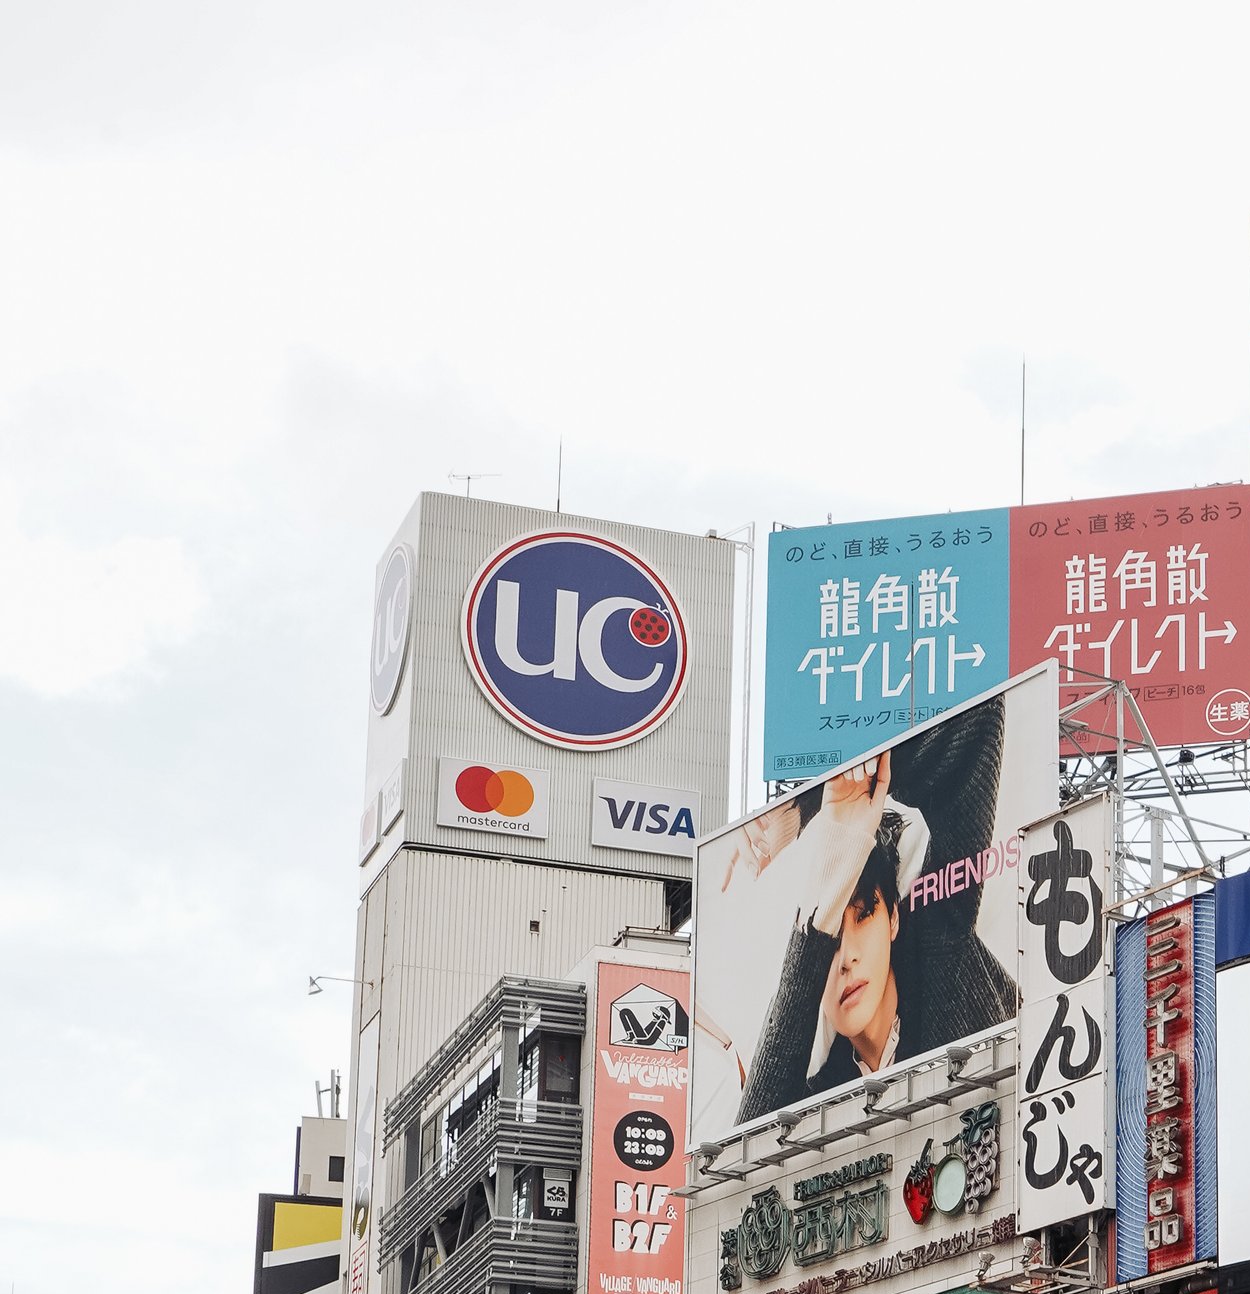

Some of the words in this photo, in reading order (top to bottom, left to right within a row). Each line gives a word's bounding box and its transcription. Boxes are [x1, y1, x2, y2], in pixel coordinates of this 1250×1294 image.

[1029, 501, 1243, 539] のど、直接、うるおう
[785, 526, 993, 564] のど、直接、うるおう
[1065, 543, 1209, 615] 龍角散
[820, 566, 960, 638] 龍角散
[1043, 611, 1237, 682] ダイレクト
[797, 634, 986, 705] ダイレクト
[1067, 687, 1141, 706] スィク
[1147, 687, 1178, 699] ピーチ
[1209, 701, 1250, 723] 生薬
[819, 710, 891, 731] スティック
[457, 813, 531, 833] mastercard
[600, 795, 697, 838] VISA
[910, 834, 1021, 912] FRI(END)S
[1026, 819, 1102, 1206] もんじゃ
[1143, 915, 1184, 1252] 三千里薬品
[549, 1208, 563, 1216] 7F
[613, 1181, 671, 1218] B1F
[612, 1218, 673, 1255] B2F
[600, 1272, 632, 1293] VILLAGE
